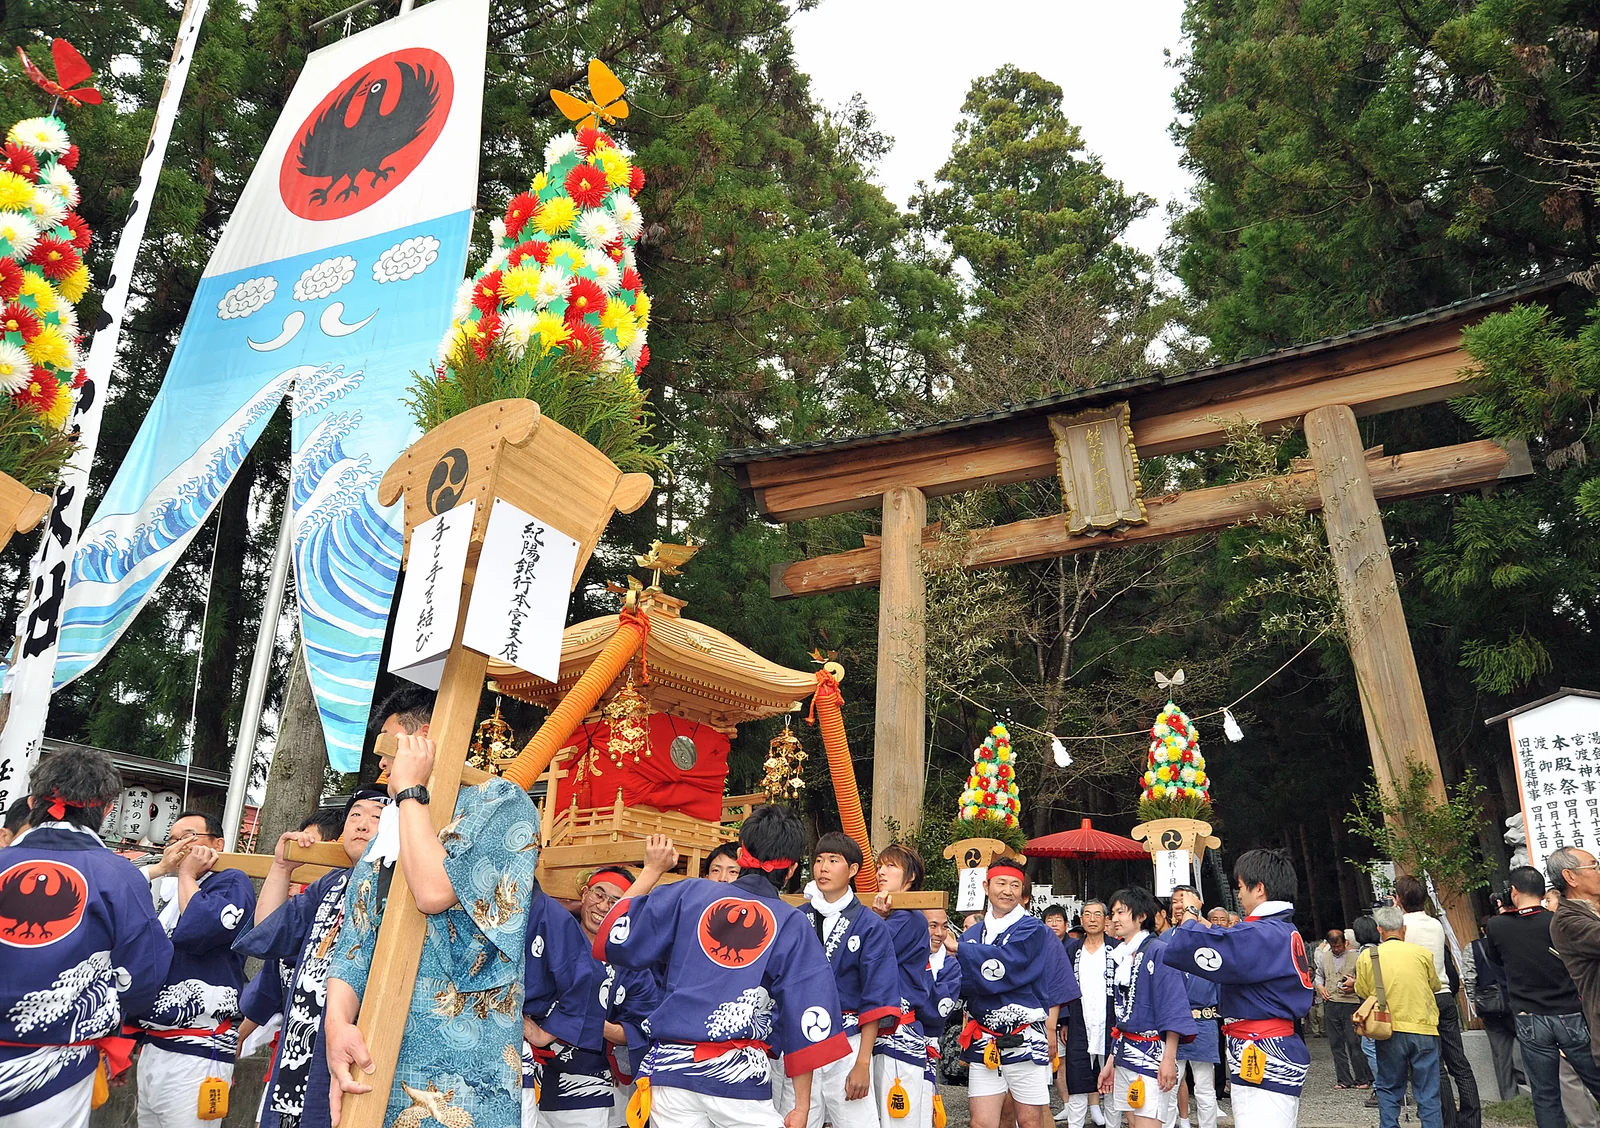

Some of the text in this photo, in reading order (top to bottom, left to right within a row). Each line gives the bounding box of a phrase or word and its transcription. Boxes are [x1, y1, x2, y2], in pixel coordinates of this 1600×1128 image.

[415, 516, 451, 652] 手と手を結び
[498, 522, 545, 663] 紀陽銀行本宮支店
[1533, 735, 1558, 796] 渡御祭
[1551, 734, 1579, 796] 本殿祭
[1571, 733, 1597, 795] 宮渡神事
[129, 799, 144, 835] 樹の里
[890, 1094, 905, 1110] 福
